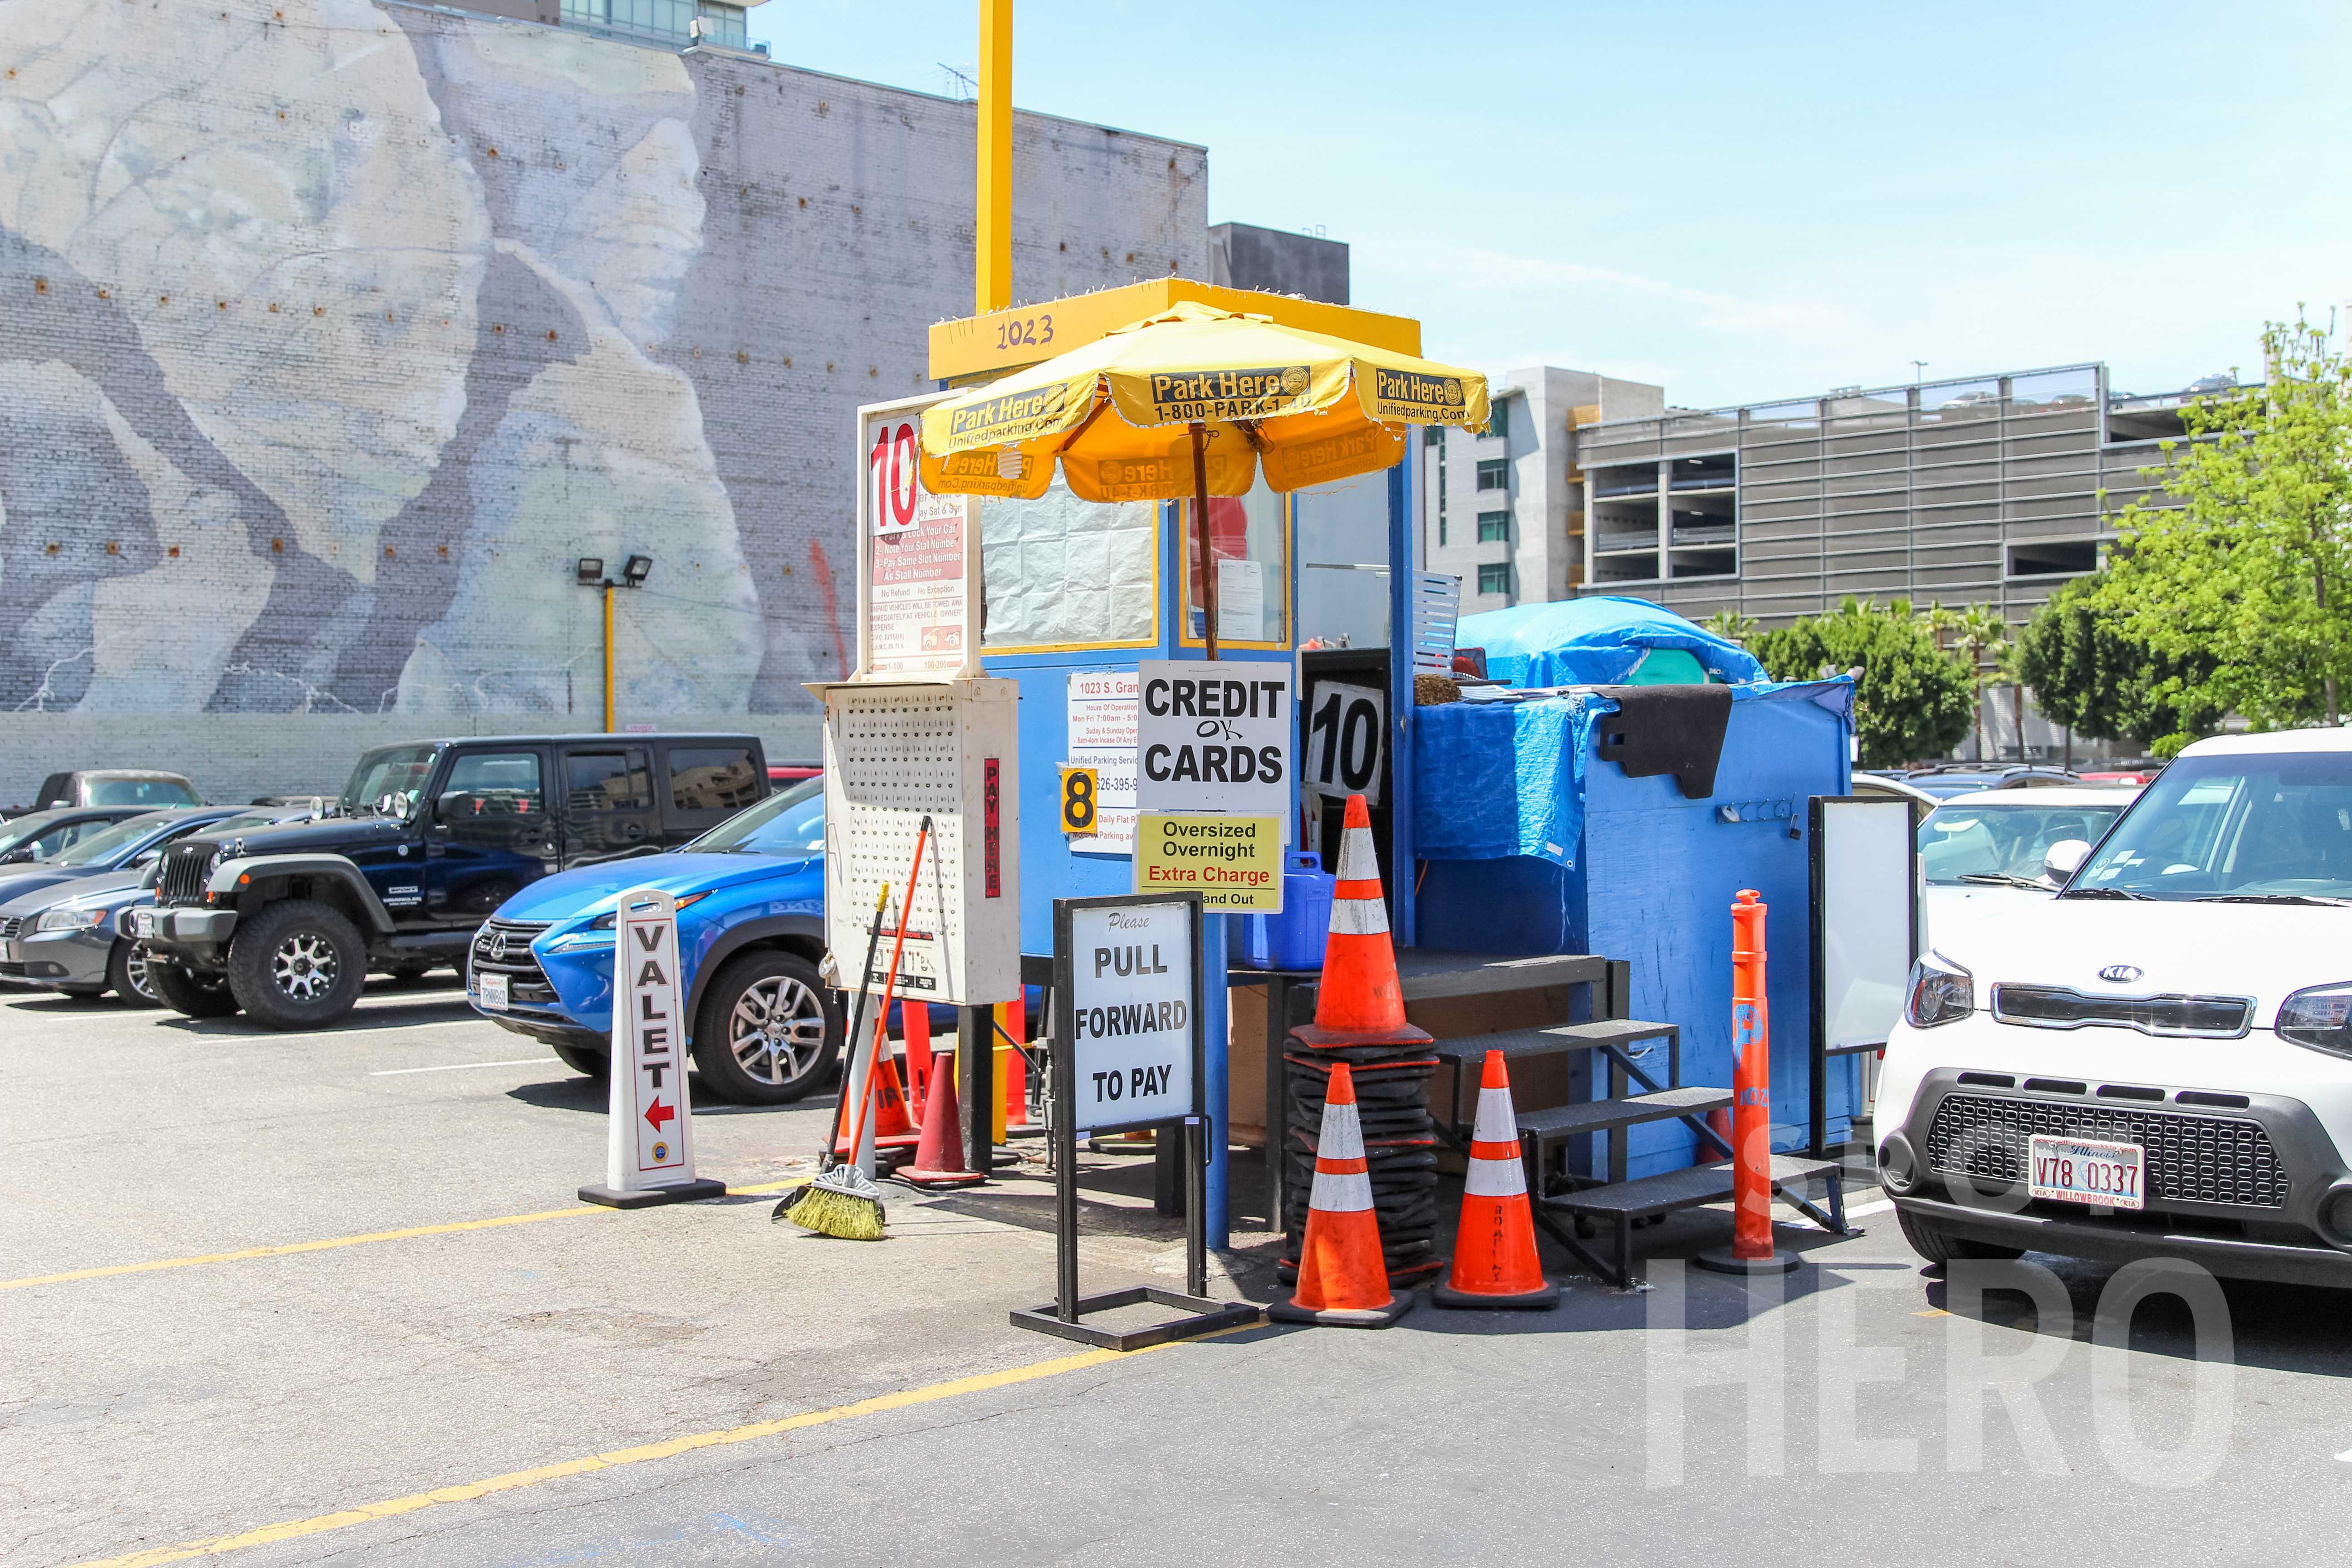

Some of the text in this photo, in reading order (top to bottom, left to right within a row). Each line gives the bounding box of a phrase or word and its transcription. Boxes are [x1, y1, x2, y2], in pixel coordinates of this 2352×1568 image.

[996, 314, 1054, 350] 1023
[1154, 372, 1280, 401] Park Here
[1378, 372, 1408, 399] Park
[1411, 376, 1444, 403] Here
[953, 403, 996, 433] Park
[998, 395, 1043, 421] Here
[1377, 402, 1470, 422] Unifiedparking.Com
[949, 418, 1063, 448] Unifiedparking.Com
[871, 423, 917, 527] 10
[929, 506, 940, 516] Sat
[926, 526, 942, 536] Your
[944, 524, 956, 534] Car
[885, 544, 900, 554] Note
[901, 543, 915, 553] Your
[916, 541, 930, 551] Stall
[931, 539, 957, 549] Number
[884, 559, 896, 569] Pay
[898, 557, 917, 566] Same
[918, 554, 931, 564] Slot
[933, 552, 960, 563] Number
[884, 568, 942, 581] As Stall Number
[891, 588, 910, 597] Refund
[927, 584, 954, 595] Exception
[889, 603, 911, 611] VEHICLES
[933, 600, 950, 608] TOWED
[952, 598, 963, 607] AWA
[914, 611, 937, 619] VEHICLE
[870, 623, 894, 632] EXPENSE
[924, 660, 947, 669] 100-200
[1080, 682, 1101, 694] 1023
[1103, 682, 1113, 694] S.
[1145, 679, 1285, 718] CREDIT
[1111, 704, 1137, 712] Operation
[1107, 727, 1125, 735] Sunday
[1123, 736, 1132, 745] Any
[1312, 692, 1379, 791] 10
[1093, 756, 1117, 766] Parking
[1145, 744, 1283, 784] CARDS
[1065, 772, 1094, 828] 8
[986, 767, 997, 889] PAY HERE
[1098, 815, 1115, 825] Daily
[1117, 815, 1129, 823] Flat
[1100, 831, 1123, 842] Parking
[1163, 821, 1256, 838] Oversized
[1162, 841, 1255, 861] Overnight
[1149, 865, 1270, 887] Extra Charge
[1203, 894, 1254, 904] and Out
[1108, 912, 1149, 932] Please
[1095, 944, 1168, 978] PULL
[2103, 967, 2135, 979] KIA
[633, 924, 672, 1089] VALET
[1075, 1000, 1186, 1039] FORWARD
[1093, 1064, 1172, 1102] TO PAY
[2034, 1137, 2136, 1152] www.willowbrookkia.com
[2069, 1145, 2116, 1159] Illinois
[2036, 1157, 2137, 1195] V78 0337
[2056, 1191, 2115, 1206] WILLOWBROOK
